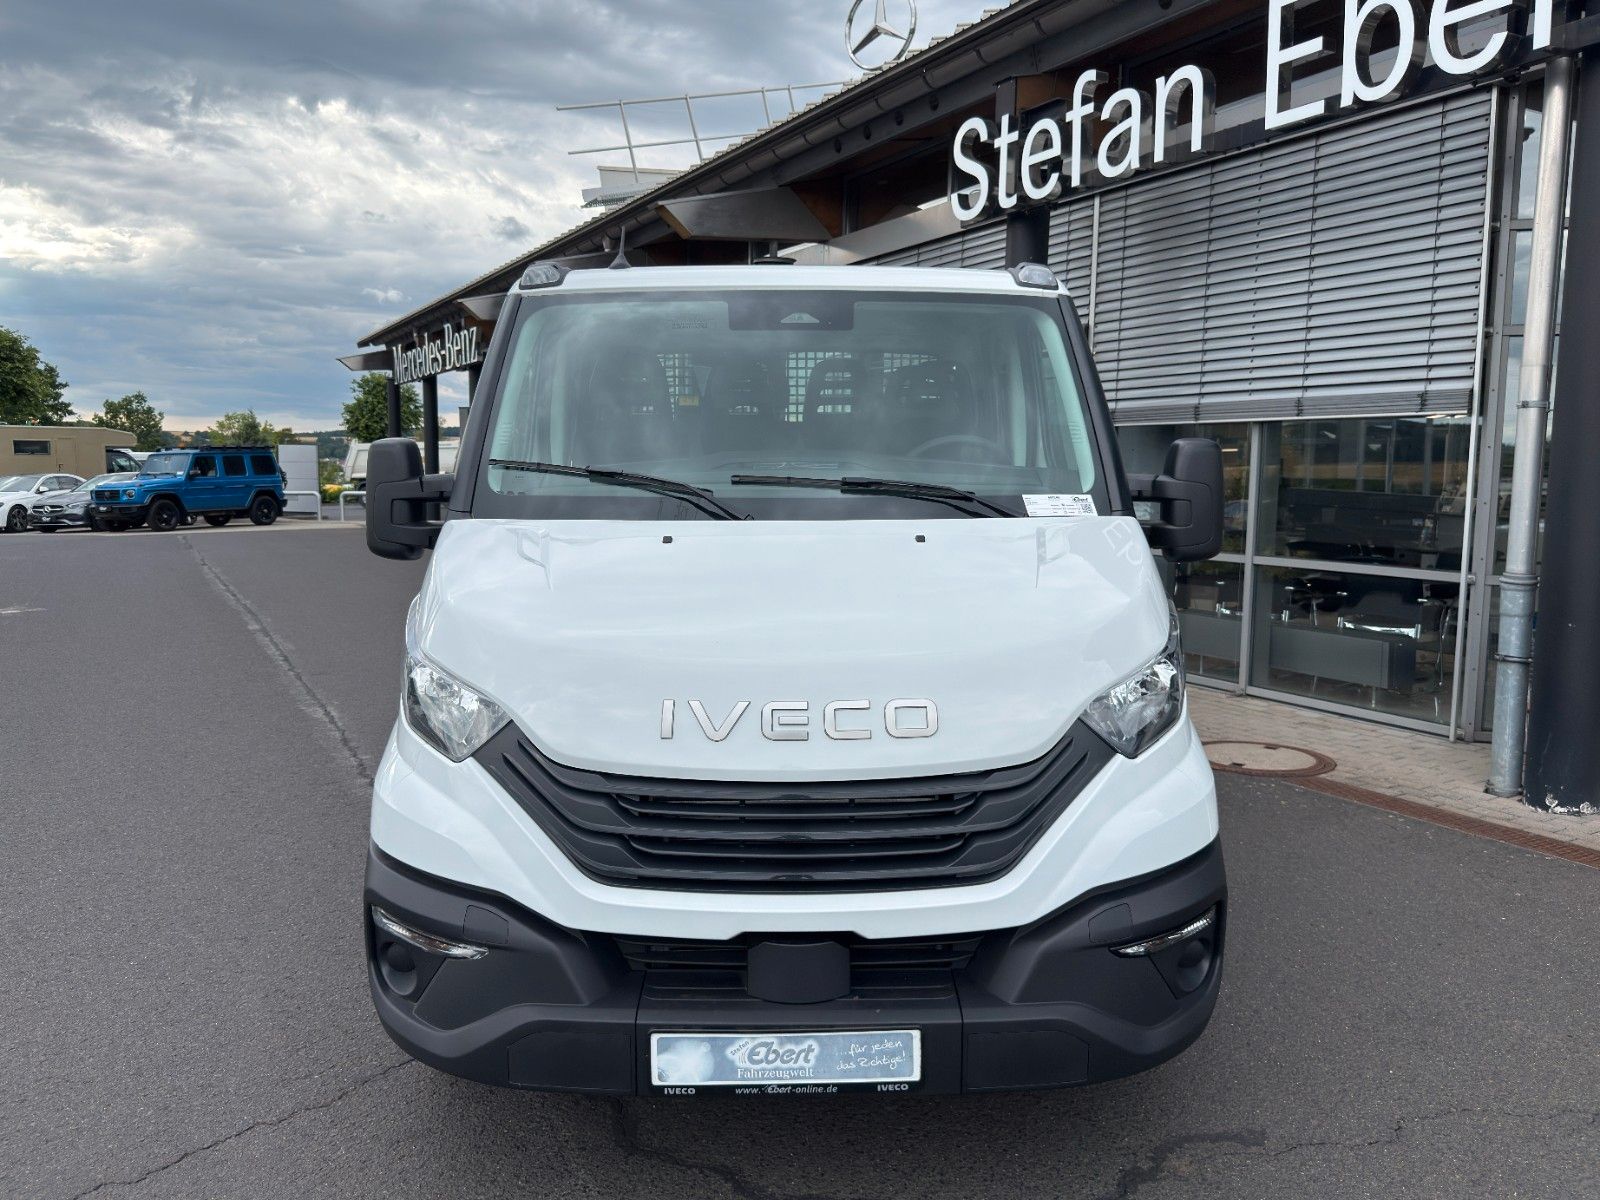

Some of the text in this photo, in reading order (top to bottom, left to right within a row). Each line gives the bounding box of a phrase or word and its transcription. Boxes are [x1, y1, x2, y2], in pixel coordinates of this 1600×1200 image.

[950, 64, 1204, 221] Stefan
[392, 323, 478, 385] Mercedes-Benz
[660, 699, 938, 742] IVECO
[747, 1041, 815, 1066] Ebert
[871, 1039, 903, 1054] jeden
[737, 1067, 814, 1080] Fahrzeugwelt
[664, 1087, 696, 1095] IVECO
[877, 1083, 909, 1092] IVECO
